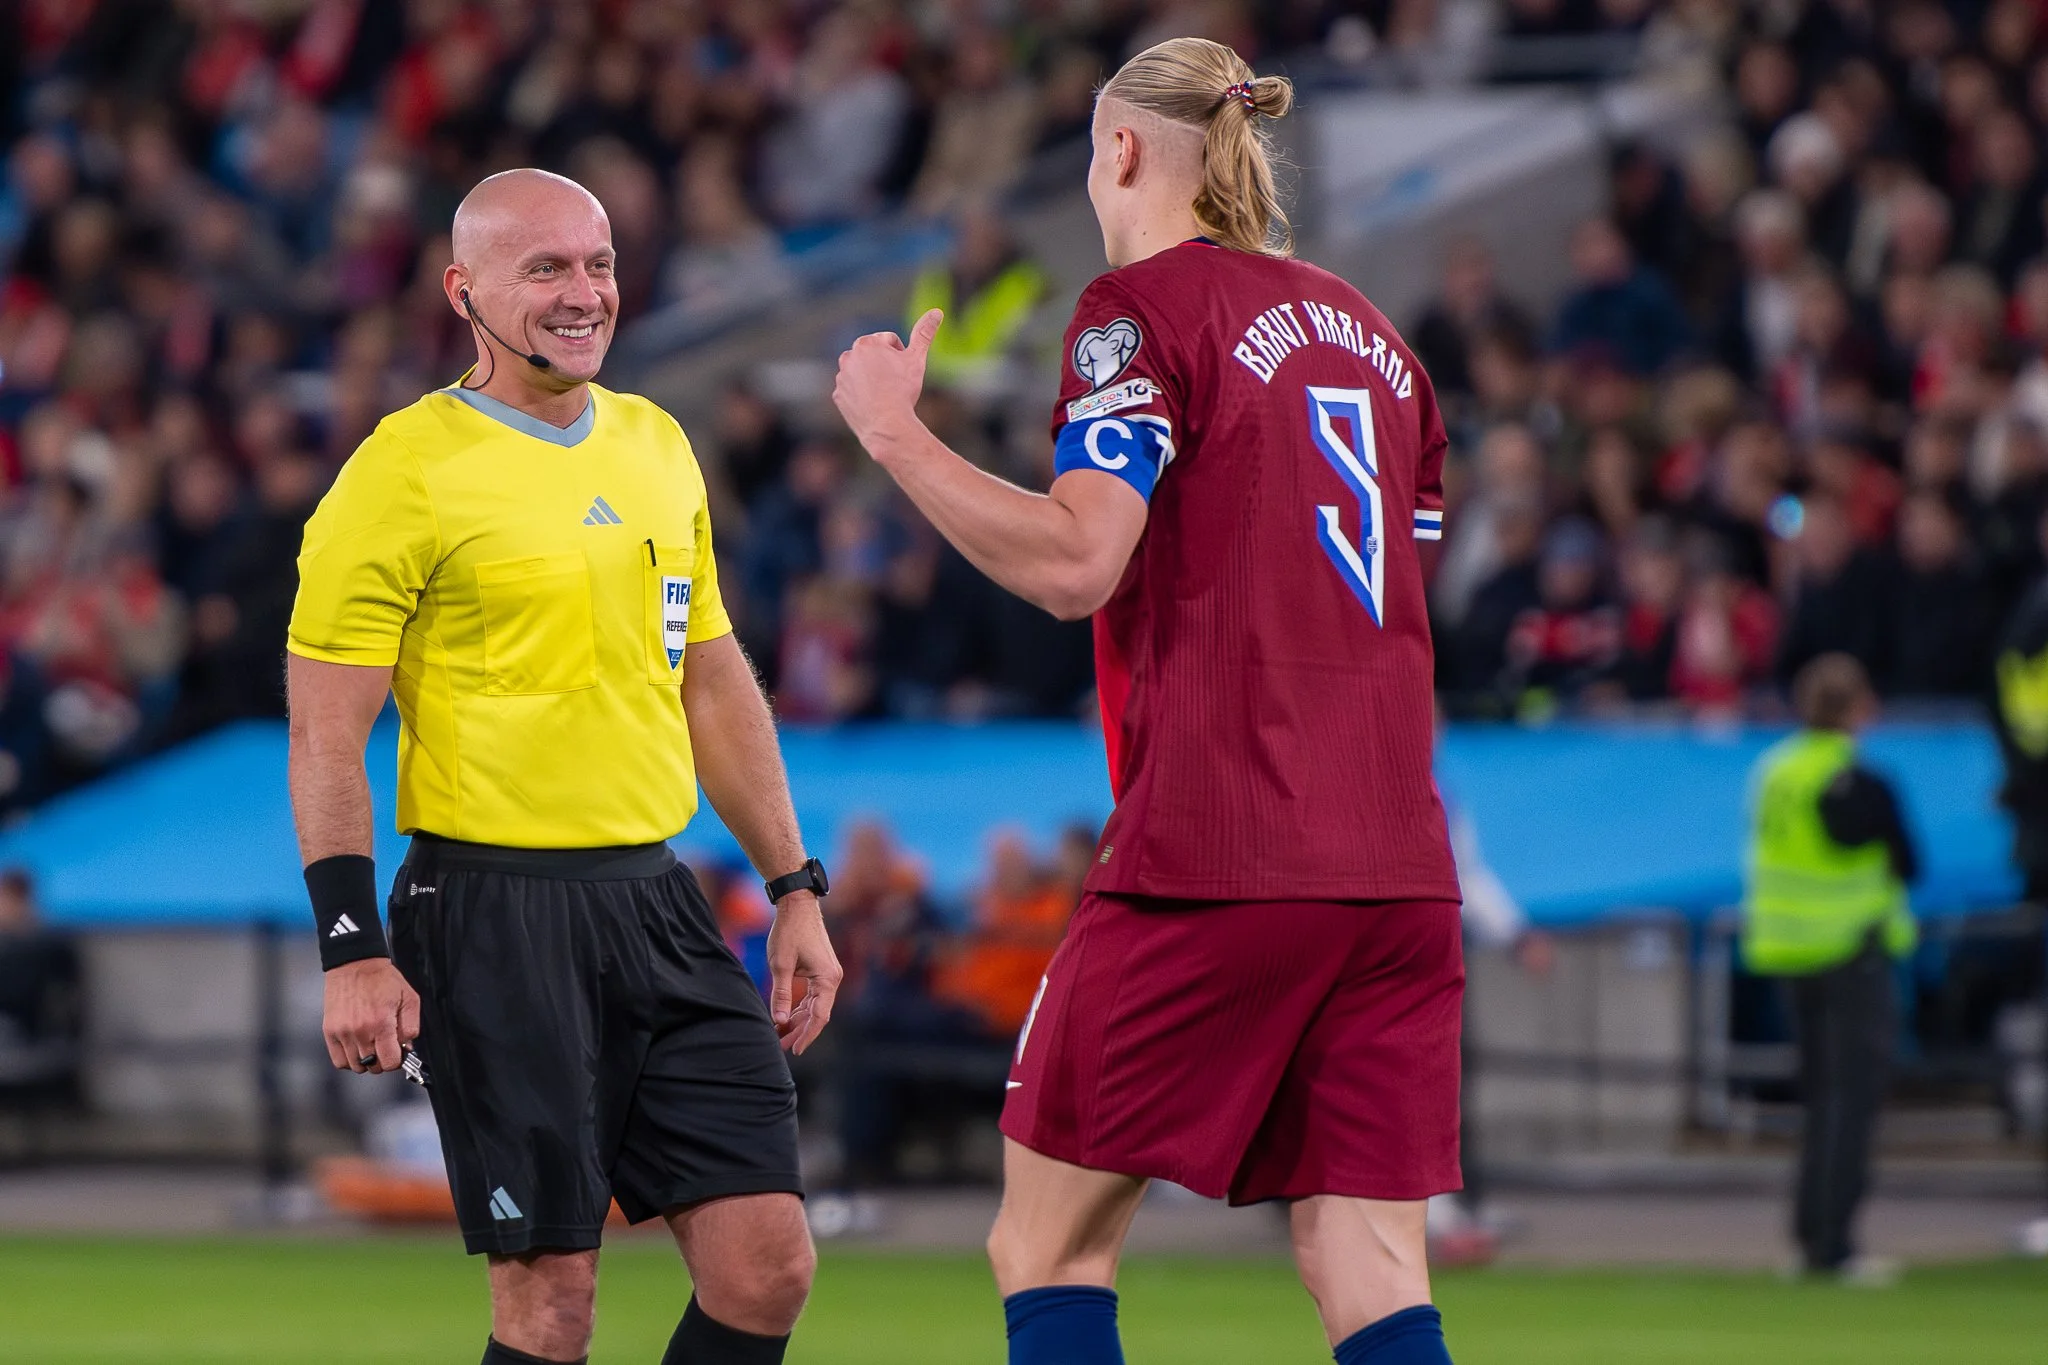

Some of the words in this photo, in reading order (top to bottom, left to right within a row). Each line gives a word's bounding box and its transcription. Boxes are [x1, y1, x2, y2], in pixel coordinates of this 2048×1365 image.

[1232, 301, 1309, 385] BRAUT
[1301, 300, 1412, 399] HAALAND
[1070, 392, 1122, 417] FOUNDATION
[1084, 418, 1133, 470] C
[1306, 385, 1385, 630] 9
[667, 582, 691, 604] FIFA
